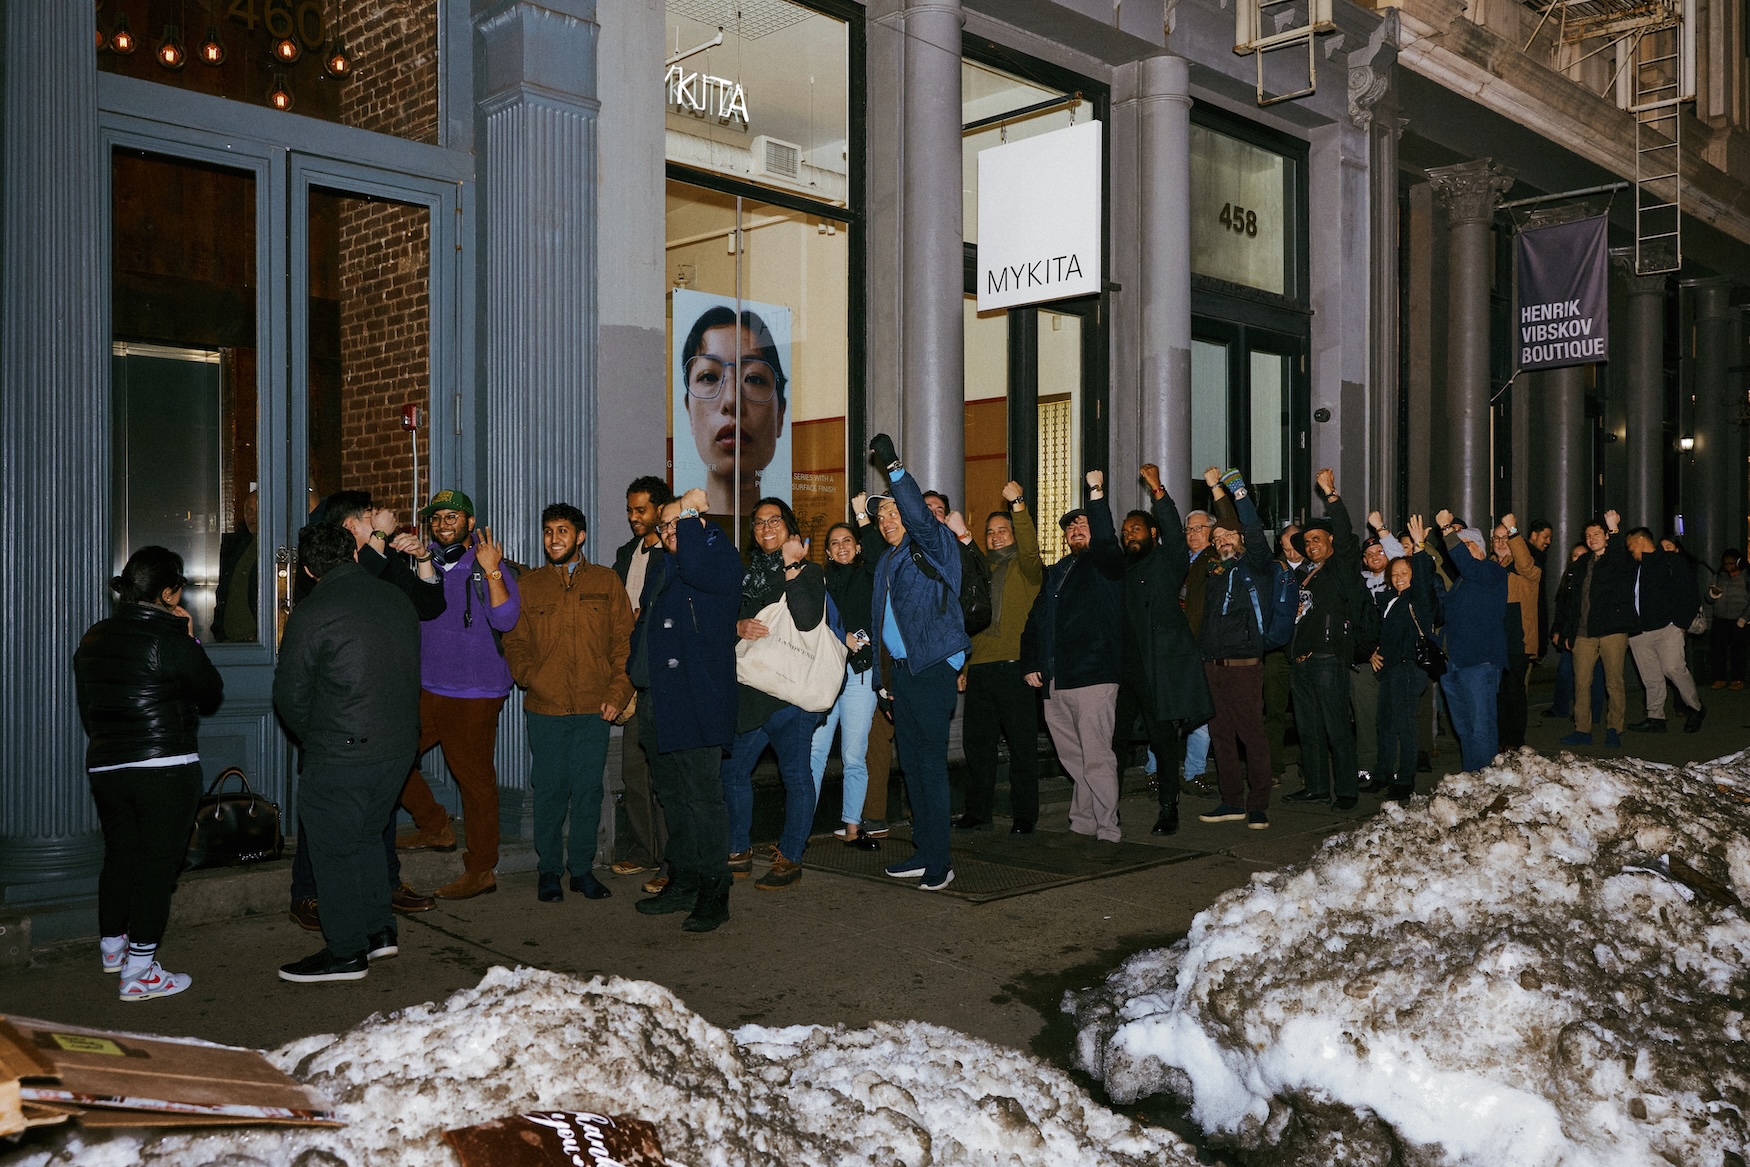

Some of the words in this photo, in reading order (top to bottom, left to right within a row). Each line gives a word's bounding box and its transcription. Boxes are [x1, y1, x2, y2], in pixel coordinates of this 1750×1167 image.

[227, 0, 326, 48] 460
[1219, 202, 1258, 238] 458
[988, 254, 1083, 294] MYKITA
[1521, 298, 1580, 323] HENRIK
[1521, 318, 1593, 343] VIBSKOV
[1522, 338, 1605, 364] BOUTIQUE
[792, 483, 817, 492] SURFACE
[818, 484, 837, 493] FINISH
[793, 472, 813, 482] SERIES
[813, 474, 830, 483] WITH
[520, 1111, 581, 1156] you
